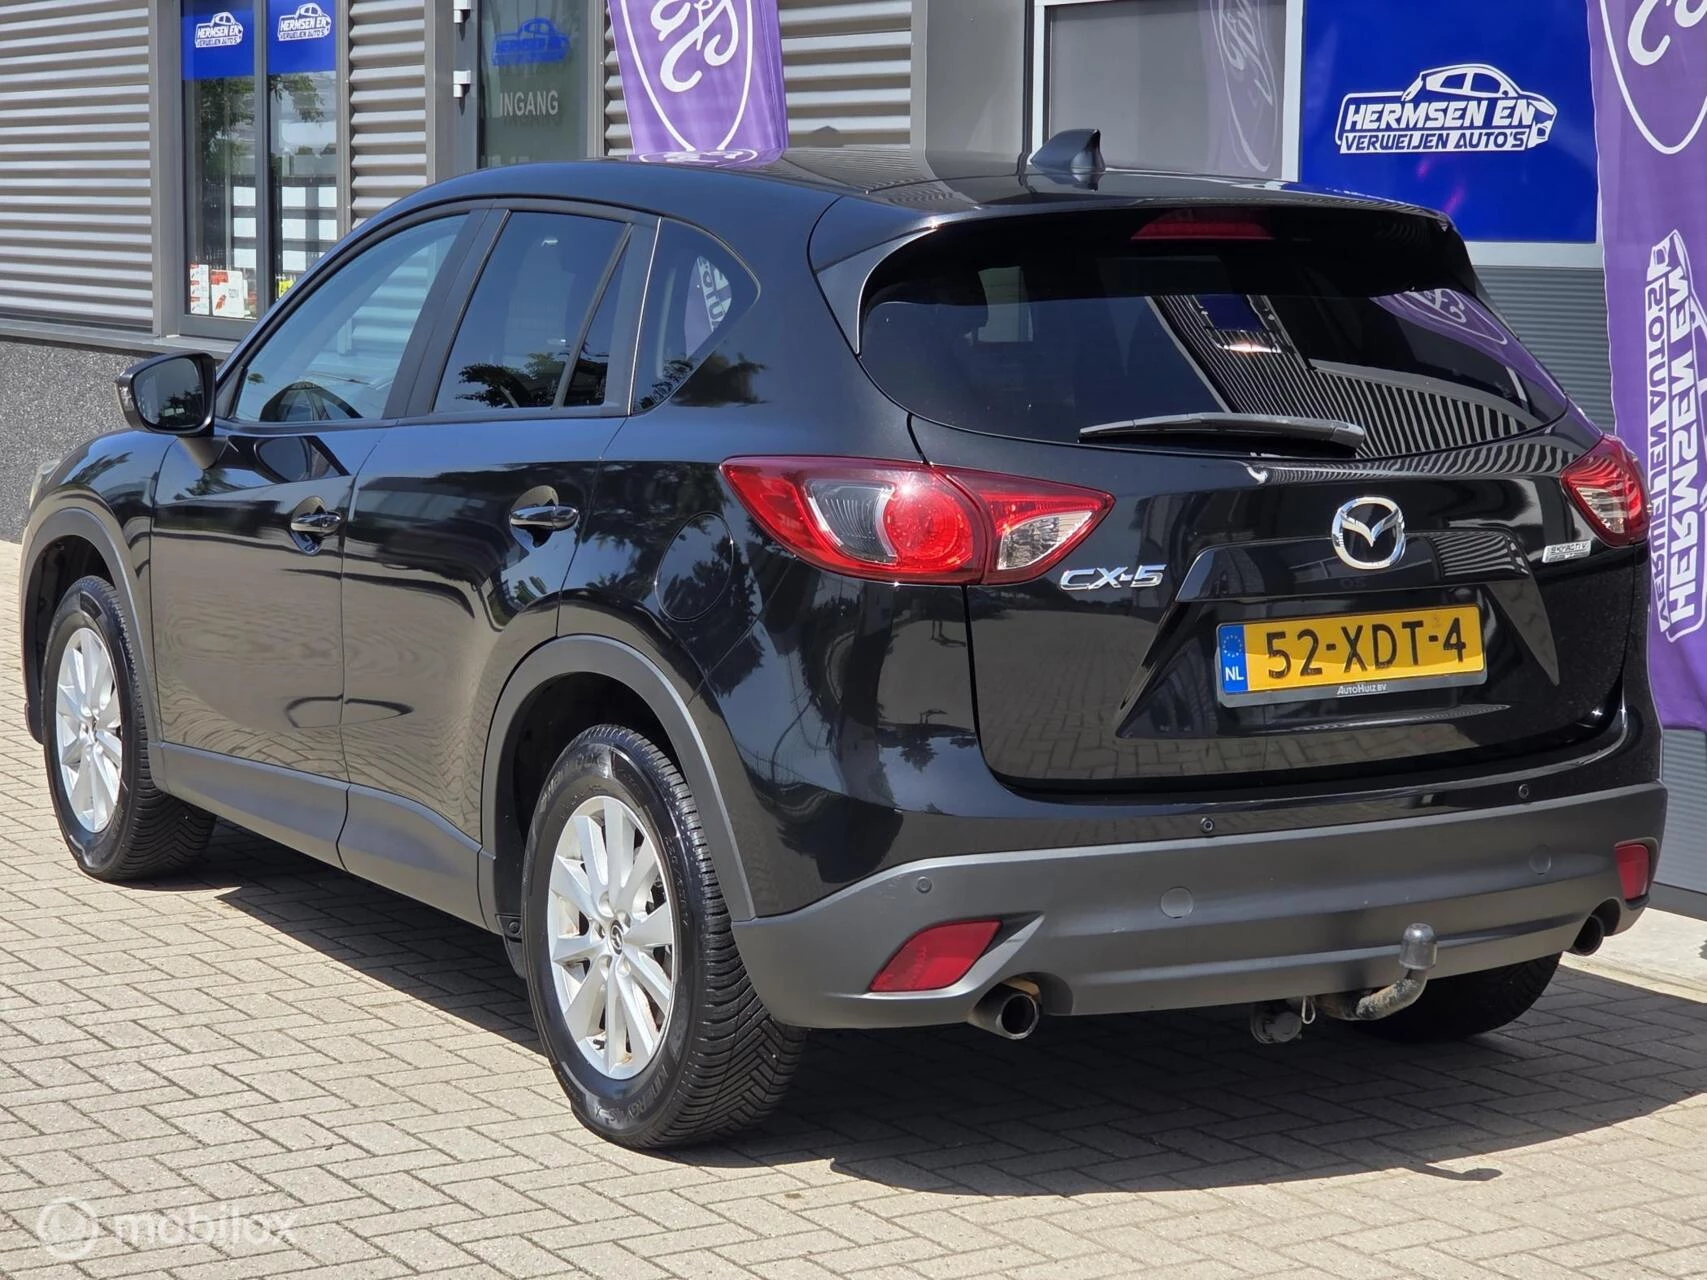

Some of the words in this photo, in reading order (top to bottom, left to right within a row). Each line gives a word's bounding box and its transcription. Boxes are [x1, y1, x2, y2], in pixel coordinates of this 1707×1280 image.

[197, 26, 228, 38] HERMSEN
[280, 18, 315, 31] HERMSEN
[500, 90, 559, 117] INGANG
[1344, 100, 1488, 130] HERMSEN
[1492, 99, 1536, 127] EN
[1345, 132, 1449, 152] VERWEIJEN
[1454, 130, 1528, 150] AUTO'S
[1060, 564, 1167, 590] CX-5
[1266, 617, 1467, 680] 52-XDT-4
[1225, 665, 1245, 682] NL
